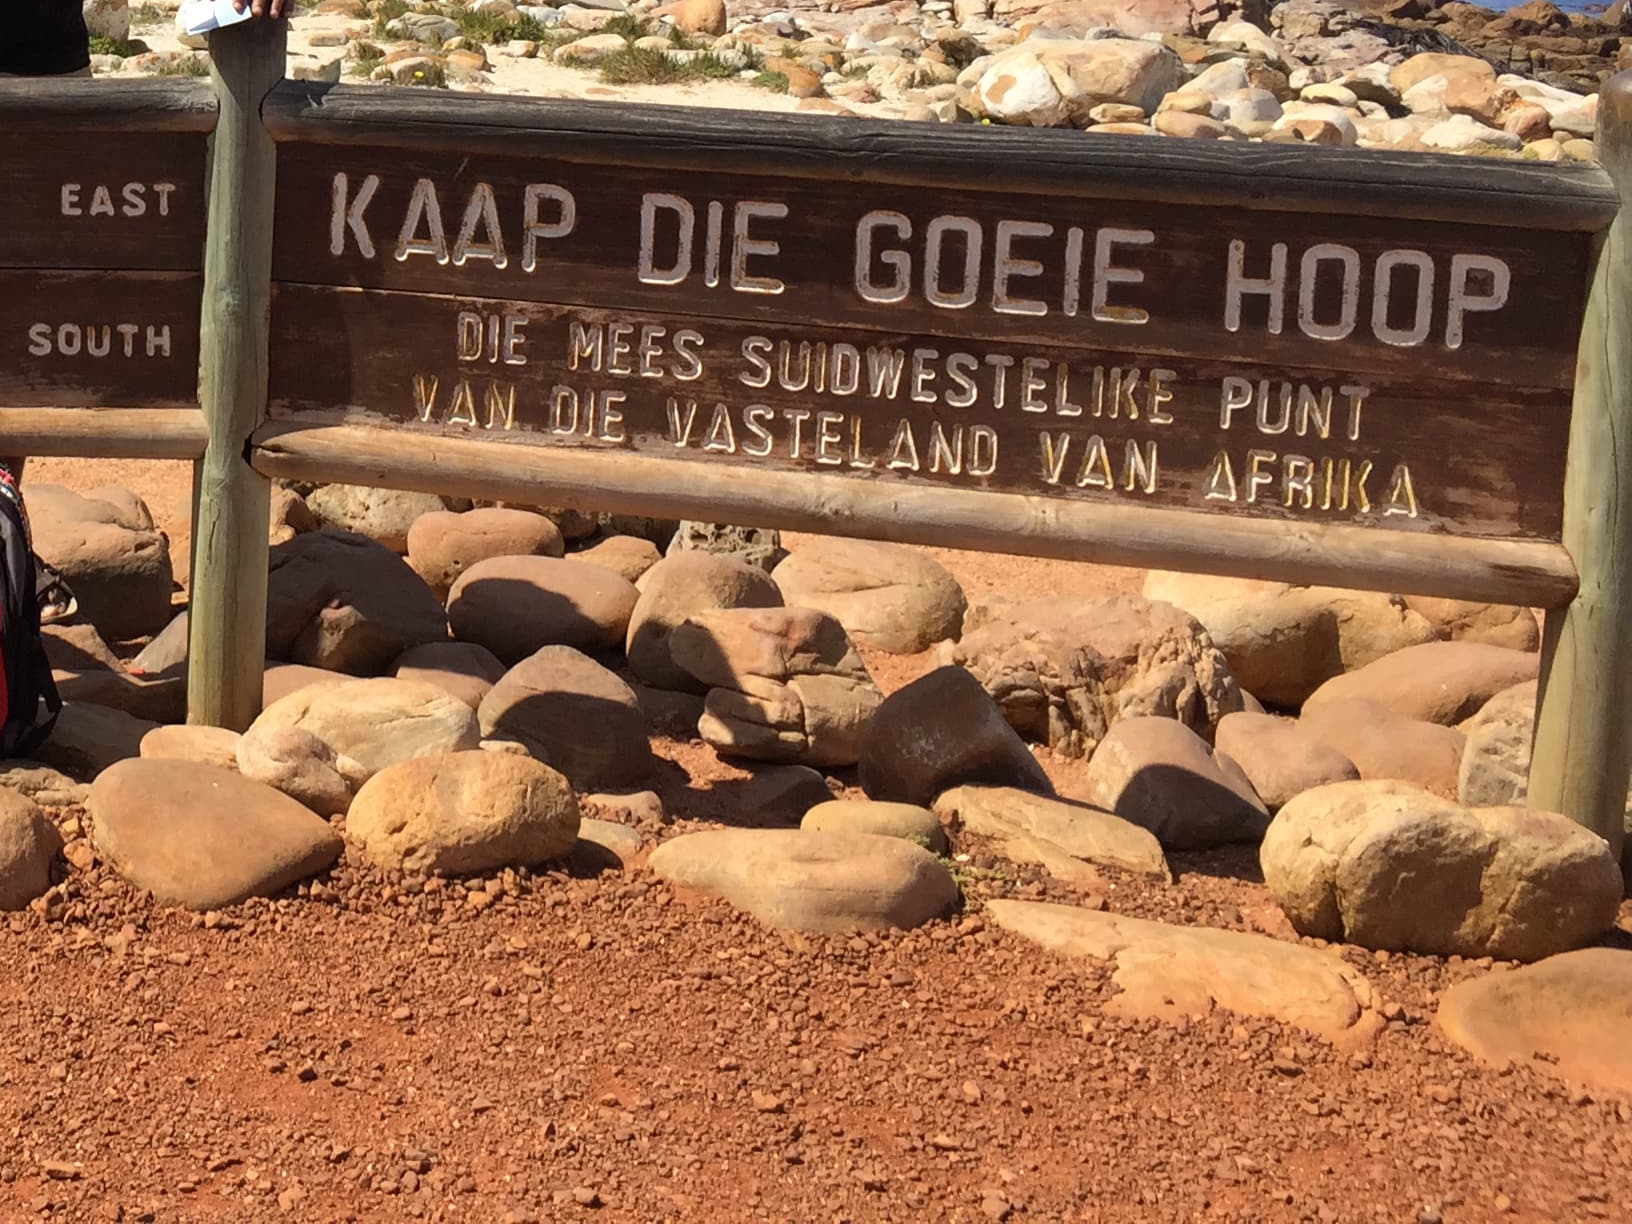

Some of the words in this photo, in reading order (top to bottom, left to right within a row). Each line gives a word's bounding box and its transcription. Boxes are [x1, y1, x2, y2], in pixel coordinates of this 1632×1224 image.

[61, 182, 176, 217] EAST
[330, 172, 576, 273] KAAP
[637, 192, 789, 295] DIE
[855, 210, 1155, 325] GOEIE
[1223, 238, 1510, 350] HOOP
[28, 323, 172, 357] SOUTH
[457, 311, 528, 366] DIE
[569, 321, 704, 380] MEES
[740, 335, 1177, 424] SUIDWESTELIKE
[1219, 376, 1369, 440] PUNT
[413, 376, 515, 430] VAN
[549, 385, 627, 443] DIE
[667, 397, 998, 475] VASTELAND
[1039, 431, 1158, 493] VAN
[1204, 448, 1418, 519] AFRIKA
